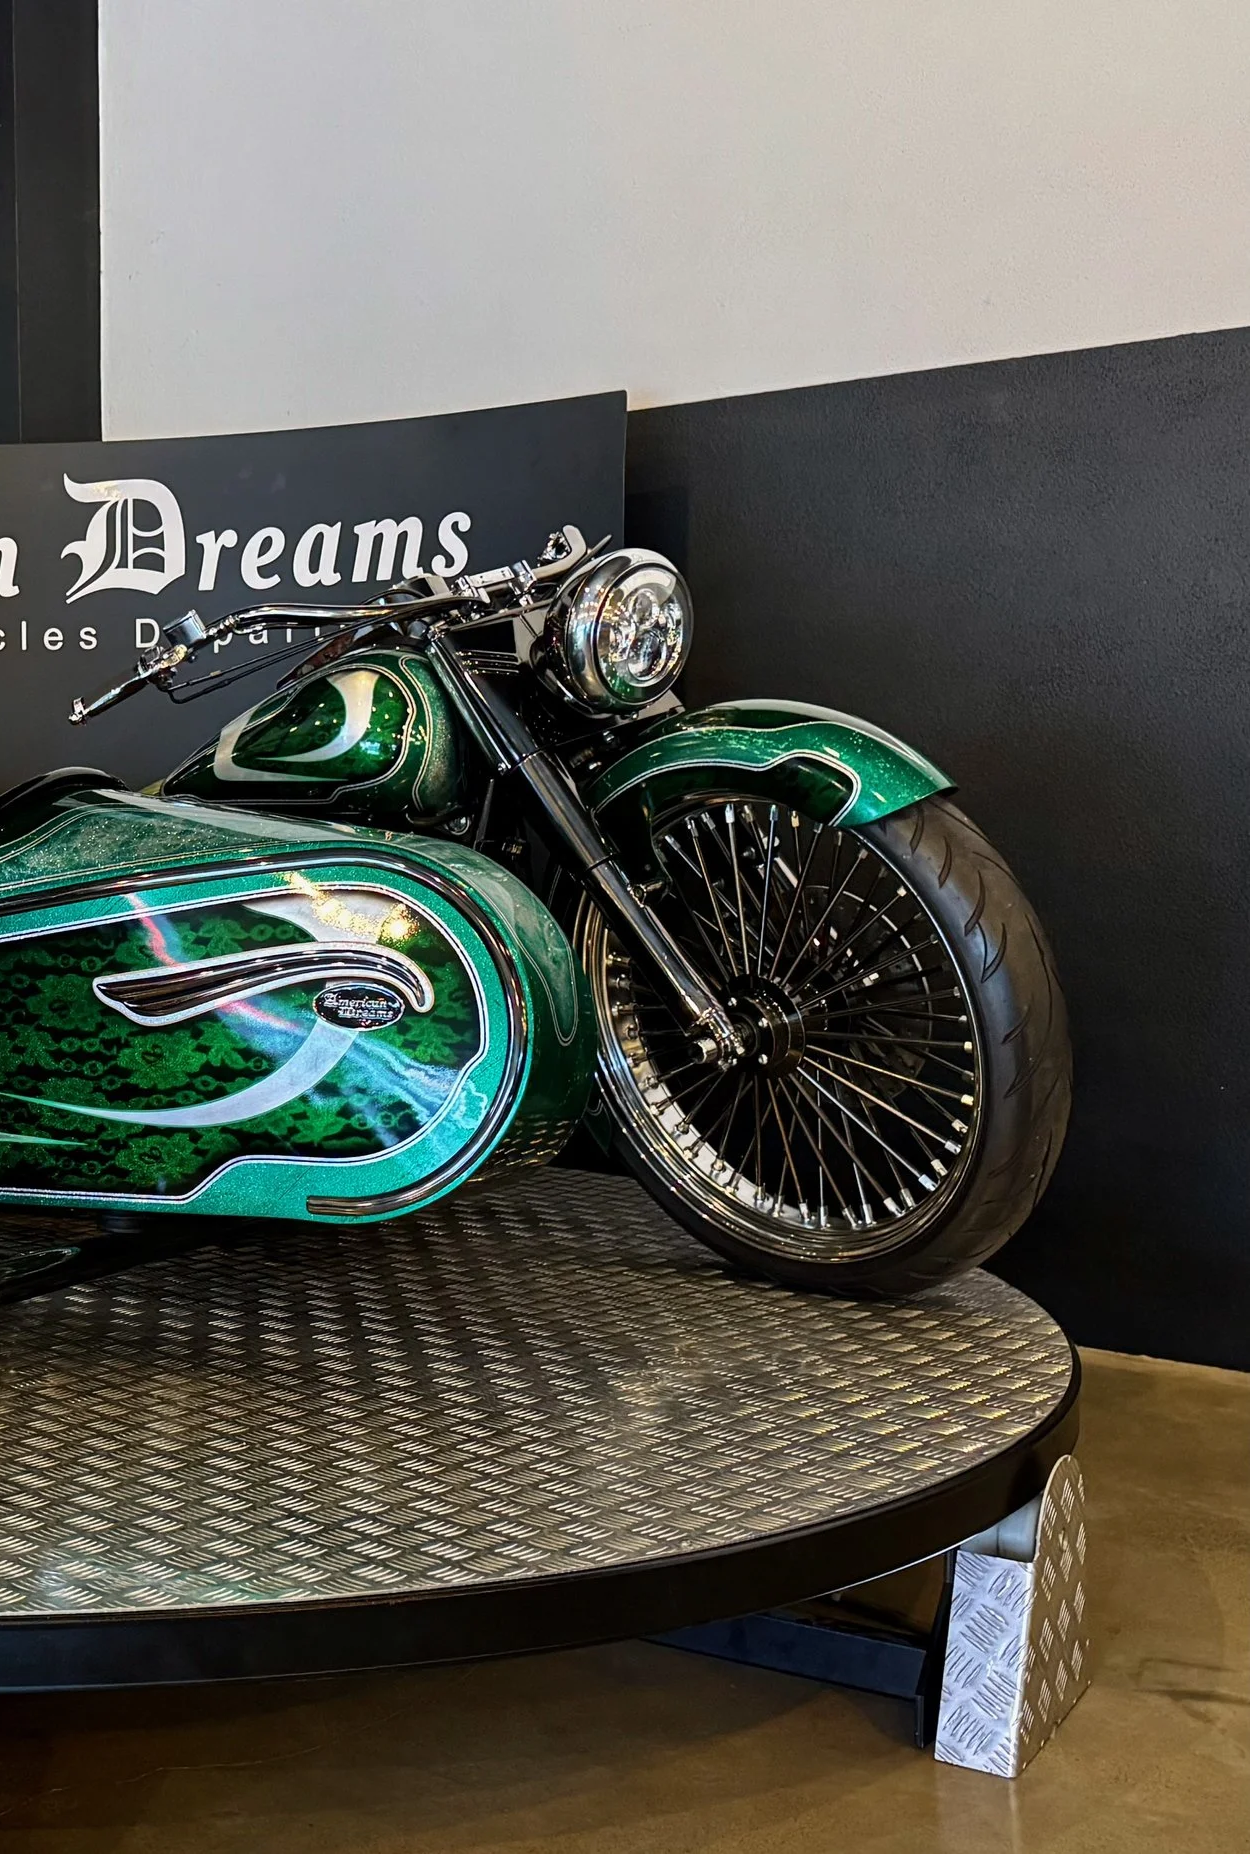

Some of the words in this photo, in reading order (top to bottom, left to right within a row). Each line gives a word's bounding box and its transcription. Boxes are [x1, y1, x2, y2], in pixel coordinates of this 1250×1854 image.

[60, 473, 472, 604] Dreams
[323, 992, 387, 1008] American
[338, 1006, 395, 1020] Dreams
